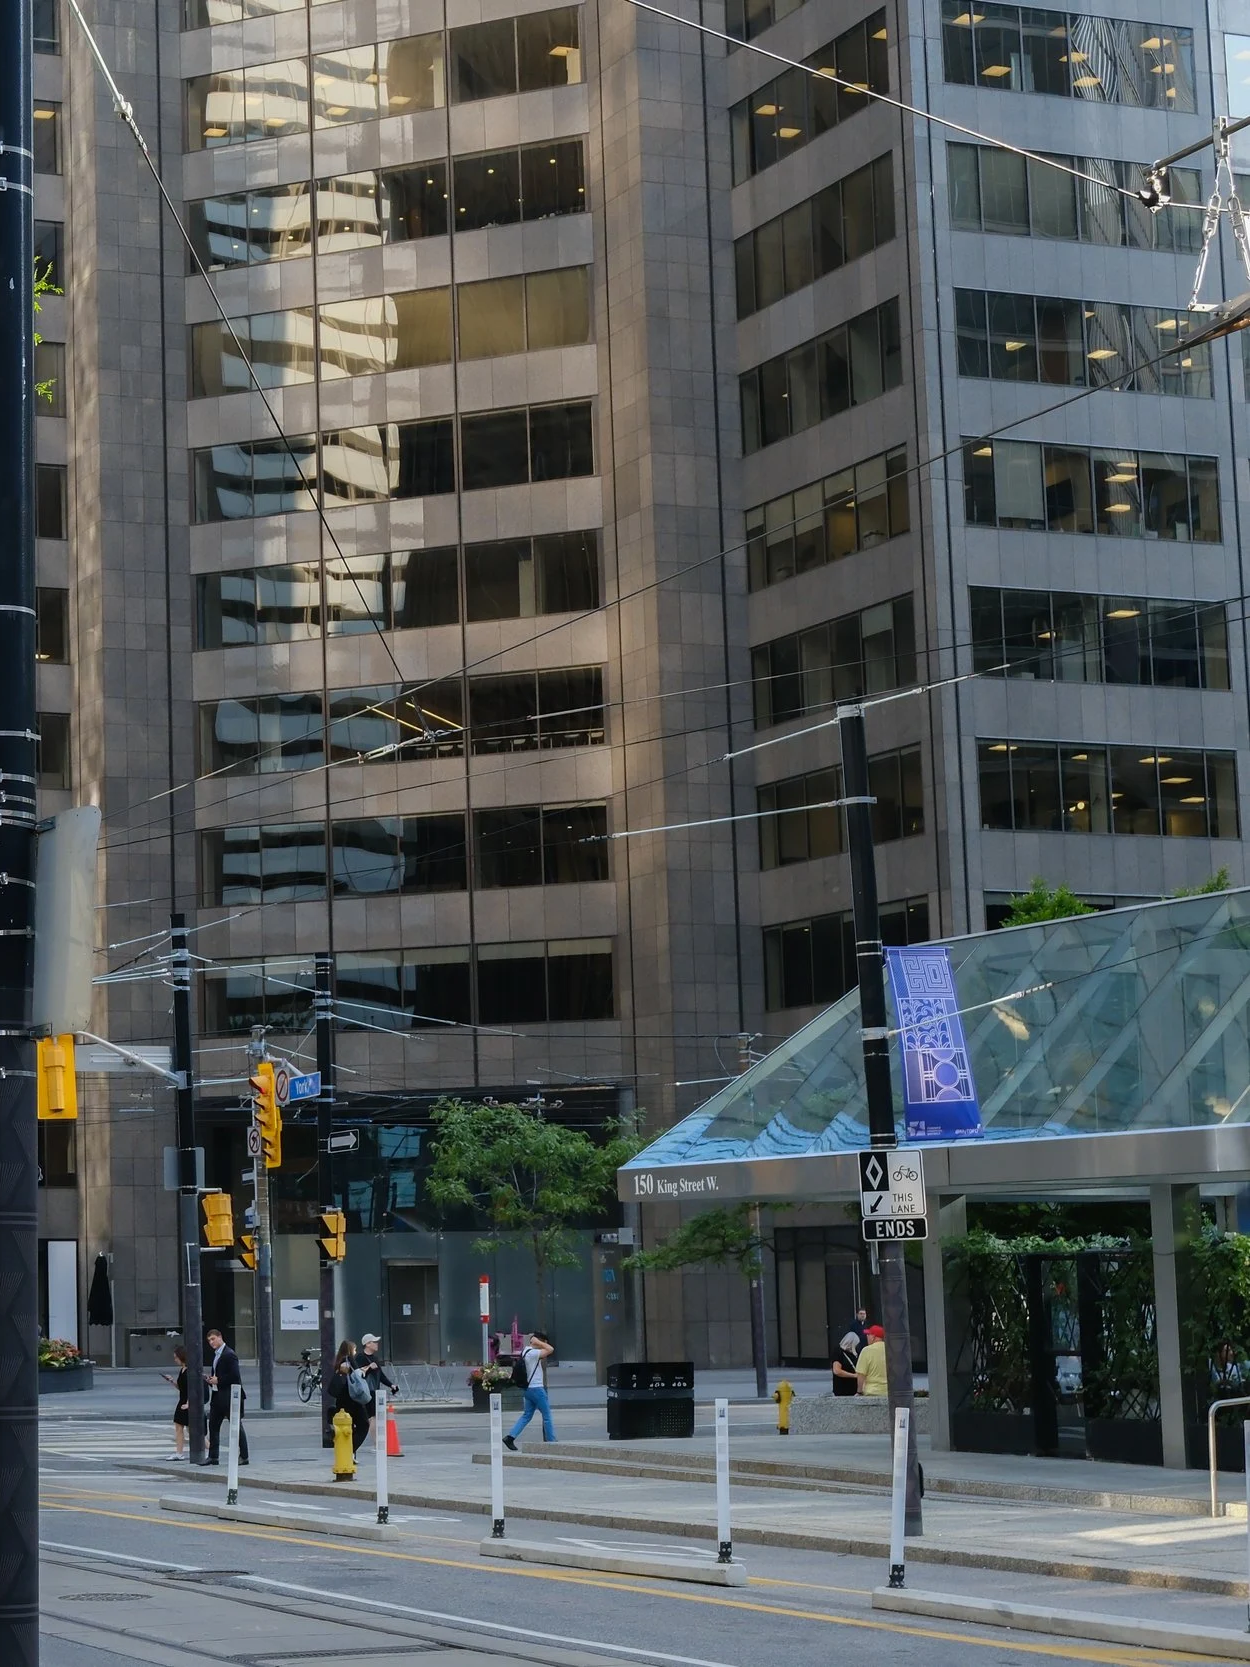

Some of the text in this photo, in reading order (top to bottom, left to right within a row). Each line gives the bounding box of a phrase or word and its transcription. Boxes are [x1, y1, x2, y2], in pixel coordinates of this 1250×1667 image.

[294, 1079, 310, 1095] York
[634, 1174, 719, 1197] 150 King Street W.
[892, 1193, 914, 1203] THIS
[891, 1204, 916, 1214] LANE
[875, 1220, 915, 1238] ENDS
